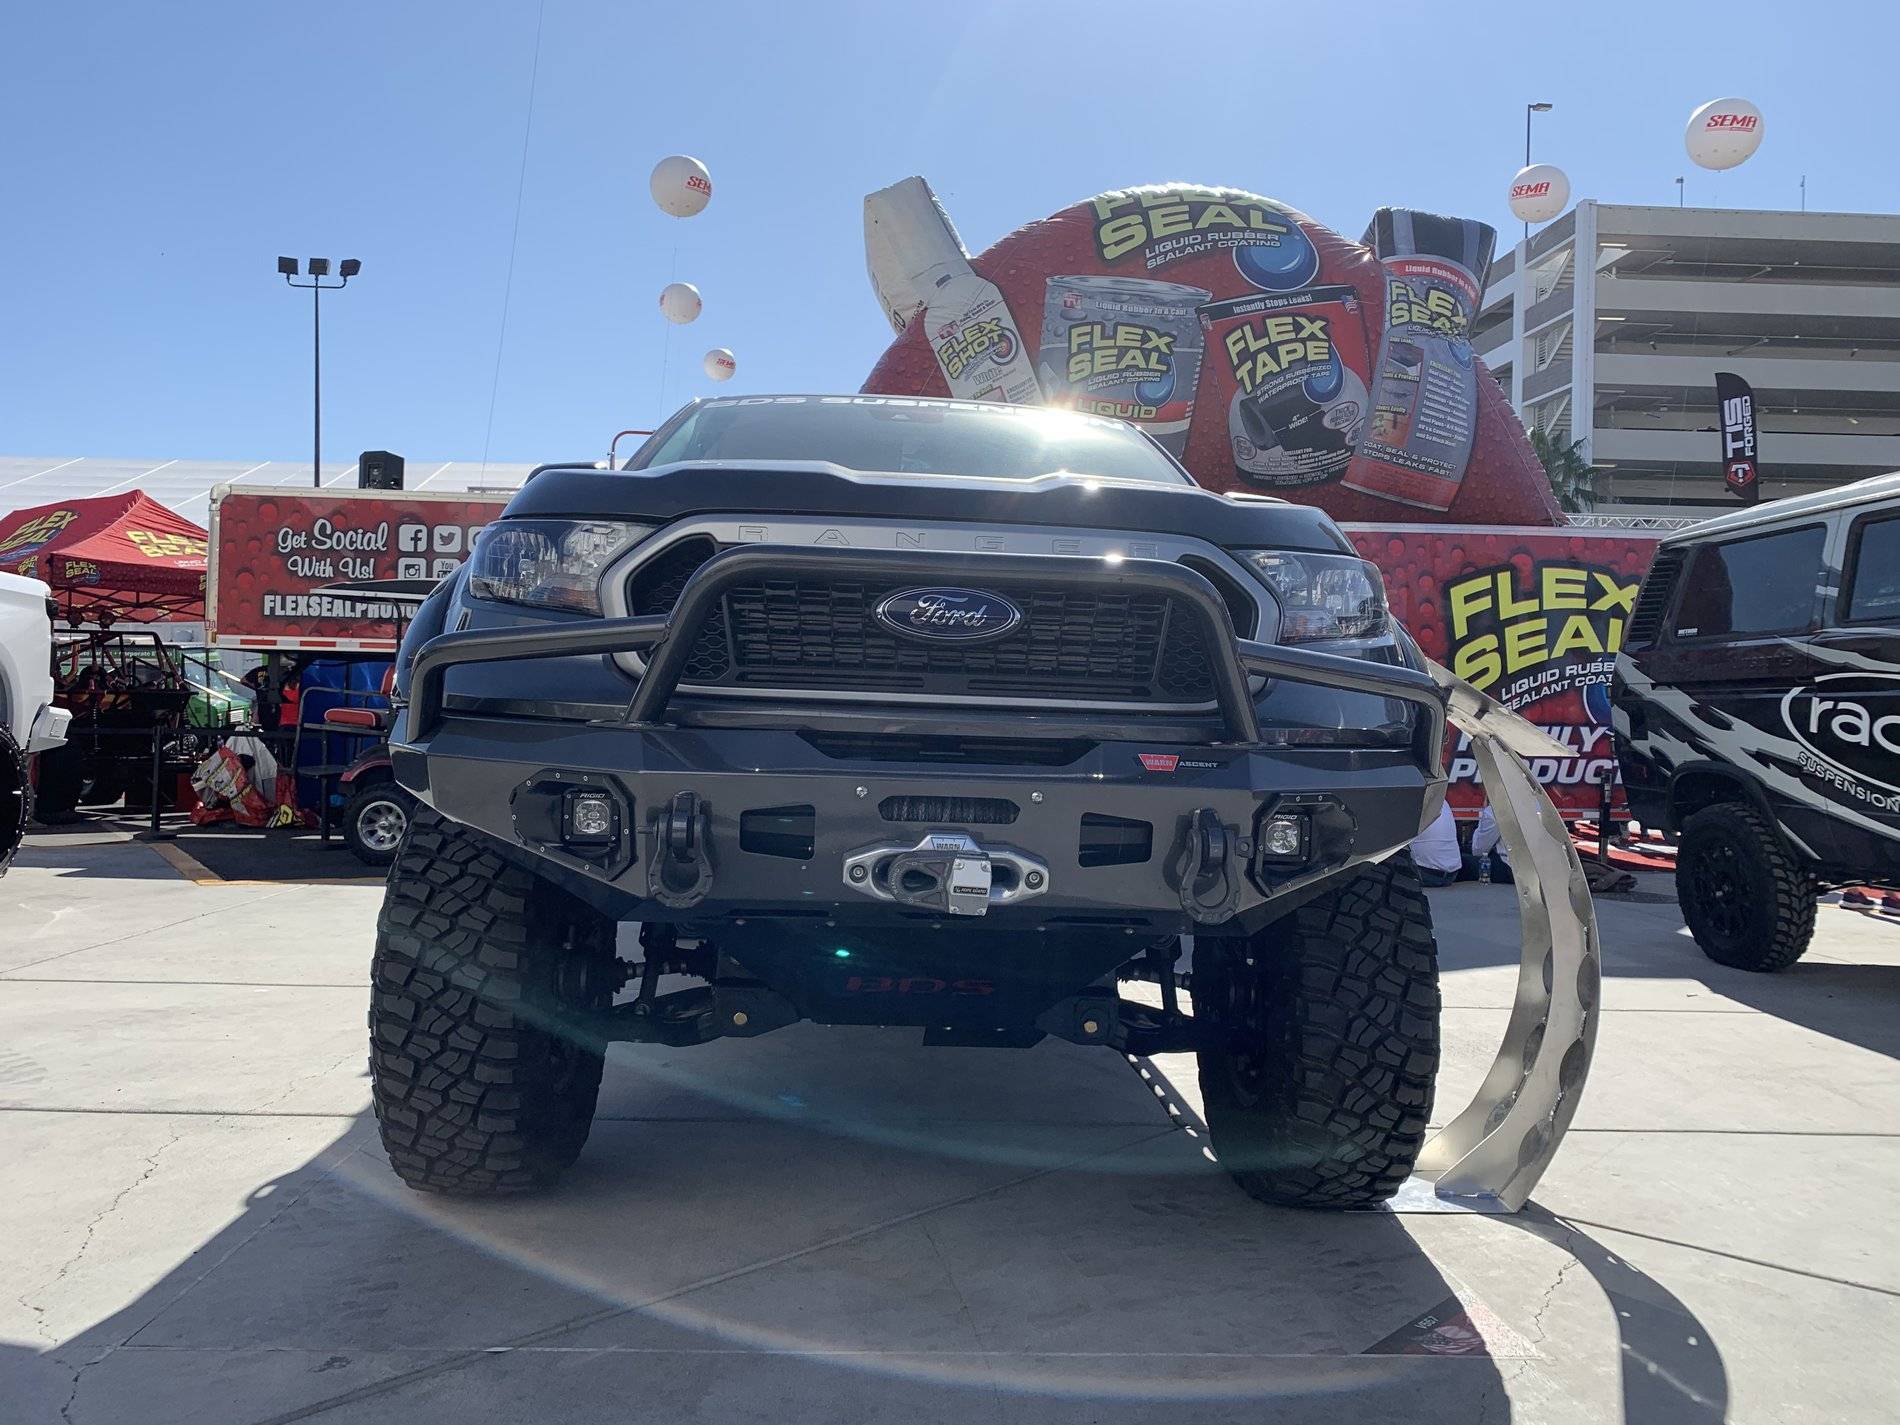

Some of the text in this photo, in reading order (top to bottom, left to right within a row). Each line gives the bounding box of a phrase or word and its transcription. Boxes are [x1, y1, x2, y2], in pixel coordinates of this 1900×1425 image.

[1706, 114, 1758, 129] SEMA
[1511, 181, 1551, 198] SEMA
[1099, 204, 1287, 260] SEAL
[1144, 230, 1280, 259] LIQUID RUBBER
[1146, 238, 1281, 269] SEALANT COATING
[1405, 264, 1431, 273] Liquid
[1095, 301, 1121, 312] Liquid
[1122, 304, 1153, 315] Rubber
[1232, 293, 1312, 314] Instantly Stops Leaks!
[939, 318, 1002, 365] FLEX
[1070, 324, 1175, 354] FLEX
[1225, 316, 1329, 367] FLEX
[947, 330, 1003, 379] SHOT
[1068, 348, 1168, 383] SEAL
[1235, 340, 1330, 394] TAPE
[1088, 370, 1161, 386] LIQUID RUBBER
[1256, 376, 1284, 397] STRONG
[1257, 371, 1330, 404] WATERPROOF TAPE
[1076, 398, 1158, 419] LIQUID
[1723, 397, 1745, 459] TIS
[1741, 395, 1755, 457] FORGED
[1363, 448, 1390, 460] STOPS
[1393, 456, 1425, 470] LEAKS
[1385, 447, 1409, 458] SEAL
[1421, 456, 1457, 469] PROTECT
[277, 518, 389, 553] Get Social
[737, 524, 1159, 558] RANGER
[64, 560, 97, 571] FLEX
[65, 567, 97, 578] SEAL
[286, 555, 376, 579] With Us!
[909, 593, 990, 628] Ford
[1450, 566, 1641, 641] FLEX
[1501, 667, 1561, 700] LIQUID
[1145, 759, 1173, 767] WARN
[1797, 752, 1900, 813] SUSPENSION
